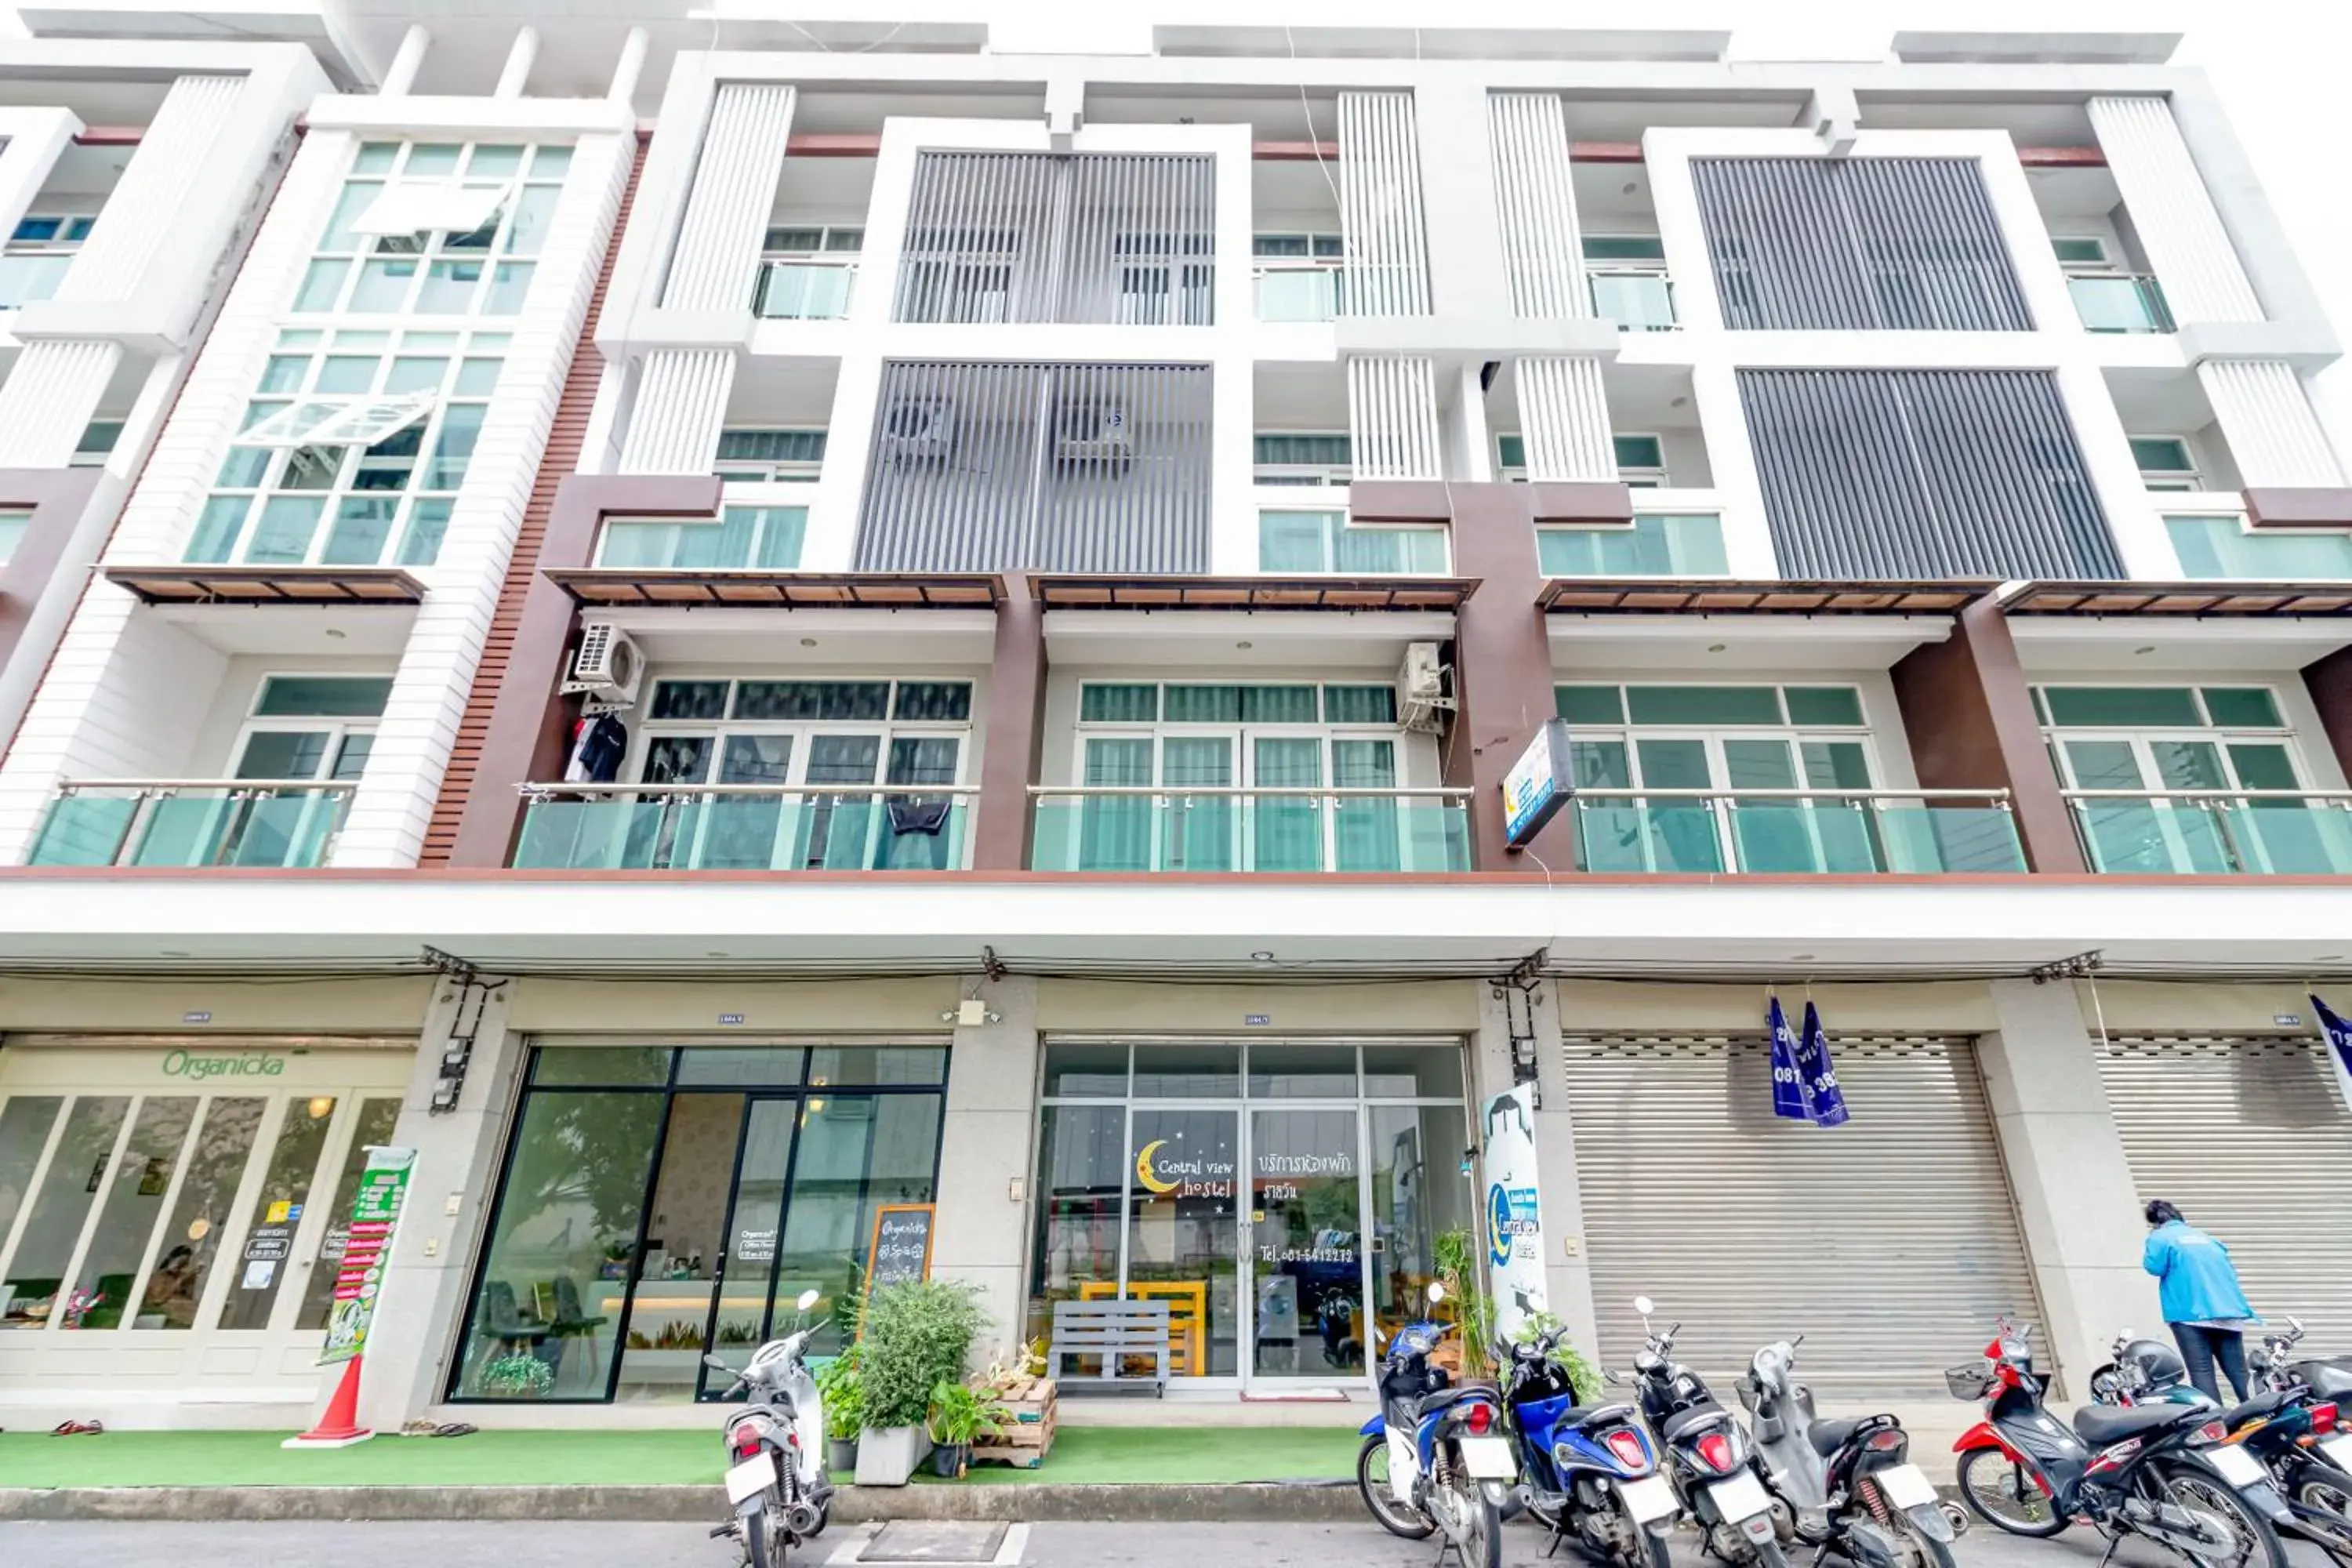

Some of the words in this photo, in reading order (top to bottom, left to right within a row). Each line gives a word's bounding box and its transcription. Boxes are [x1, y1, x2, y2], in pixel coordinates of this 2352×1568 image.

[162, 1048, 285, 1080] Organicka
[1159, 1159, 1201, 1174] Central
[1207, 1162, 1233, 1174] view
[1185, 1177, 1230, 1198] hostel
[1263, 1181, 1298, 1200] รายวัน
